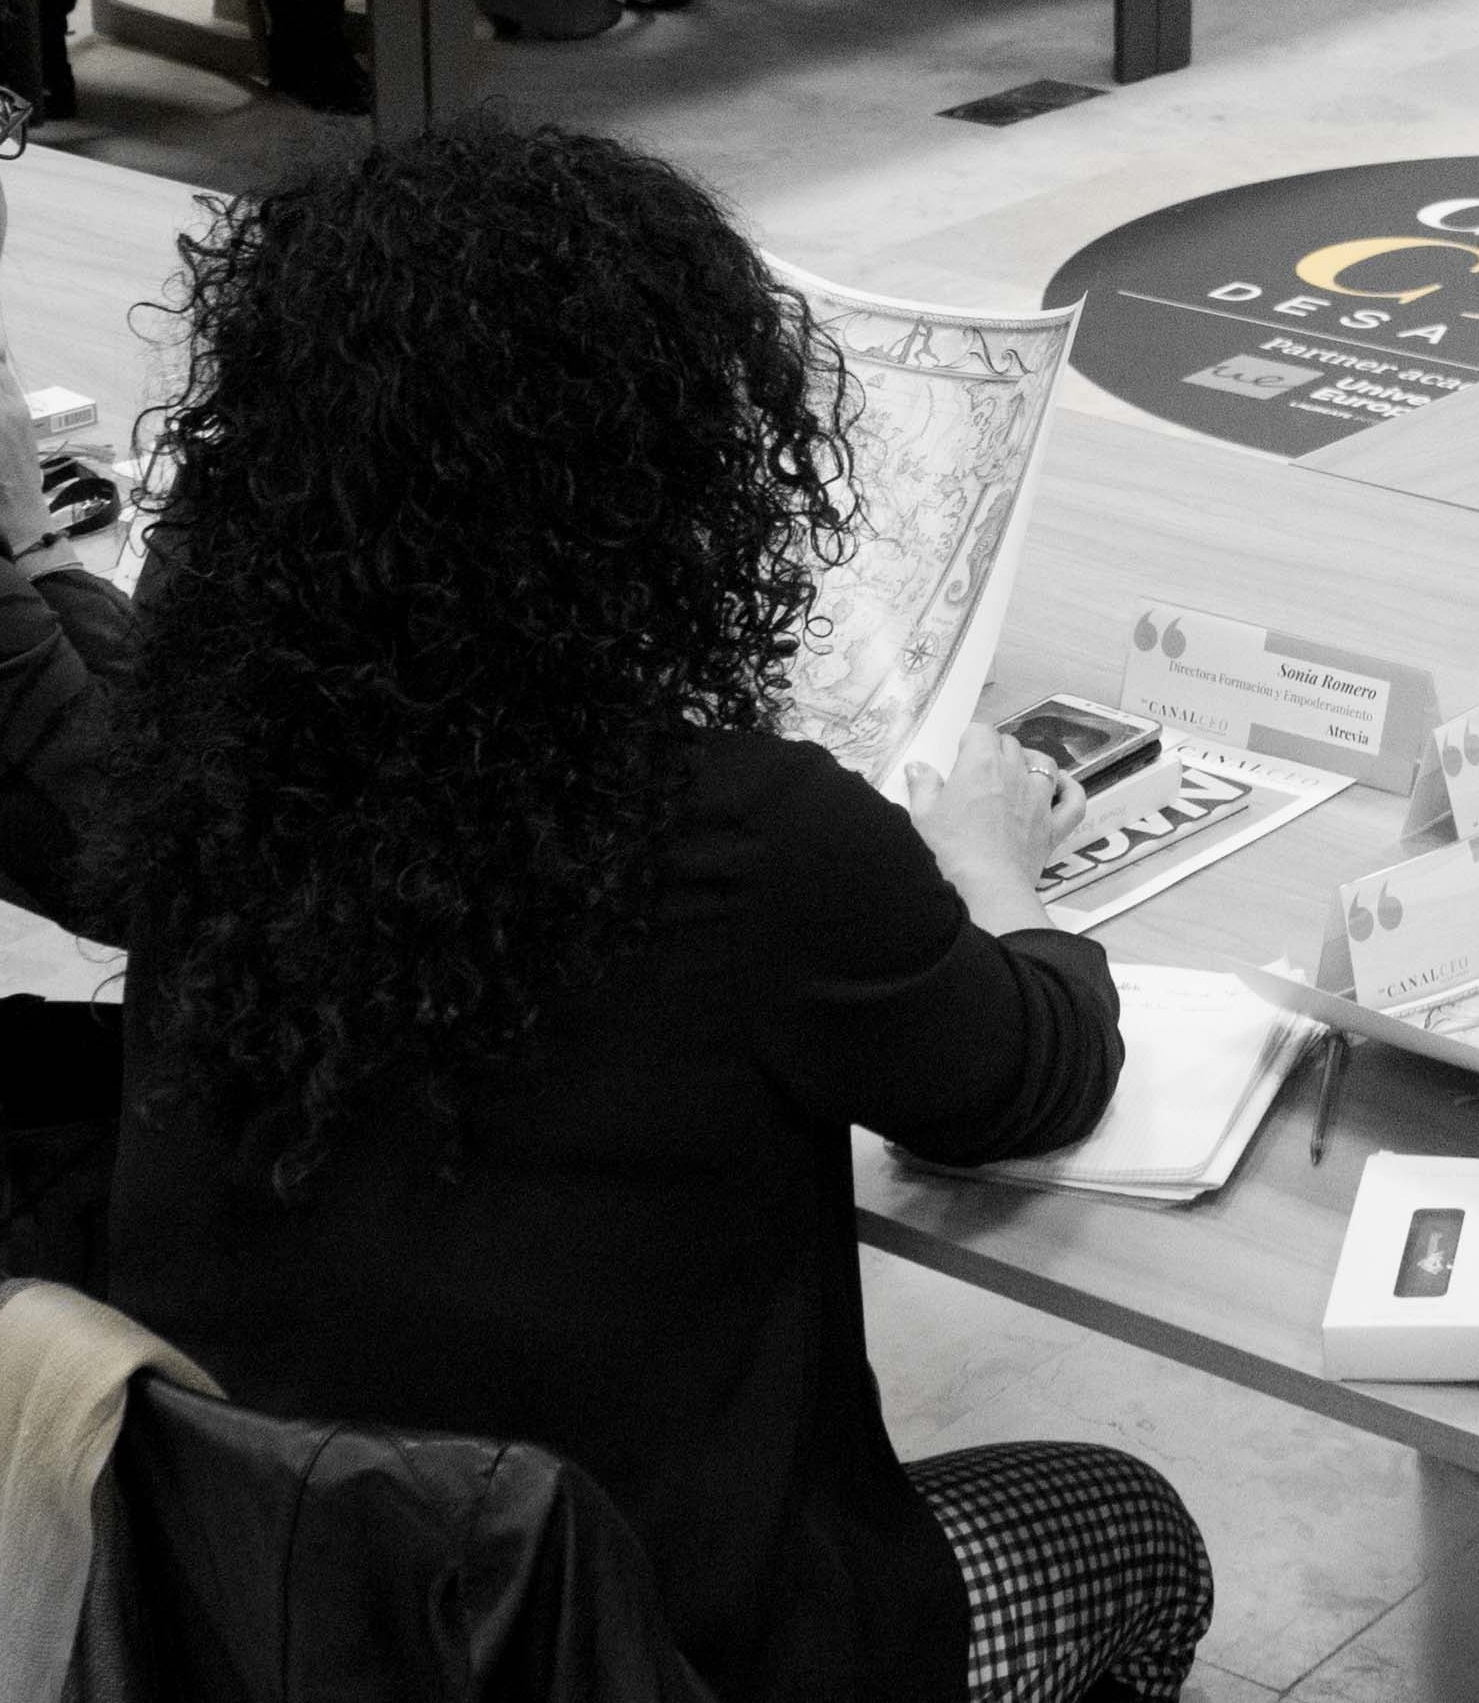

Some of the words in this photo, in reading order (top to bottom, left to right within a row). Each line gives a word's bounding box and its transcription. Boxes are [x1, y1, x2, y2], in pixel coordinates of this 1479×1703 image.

[1258, 336, 1399, 376] Partner
[1168, 659, 1218, 683] Directora
[1219, 672, 1273, 697] Formación
[1283, 688, 1375, 723] Empoderamiento
[1278, 662, 1319, 687] Sonia
[1321, 673, 1378, 701] Romero
[1326, 723, 1370, 746] Atrevia
